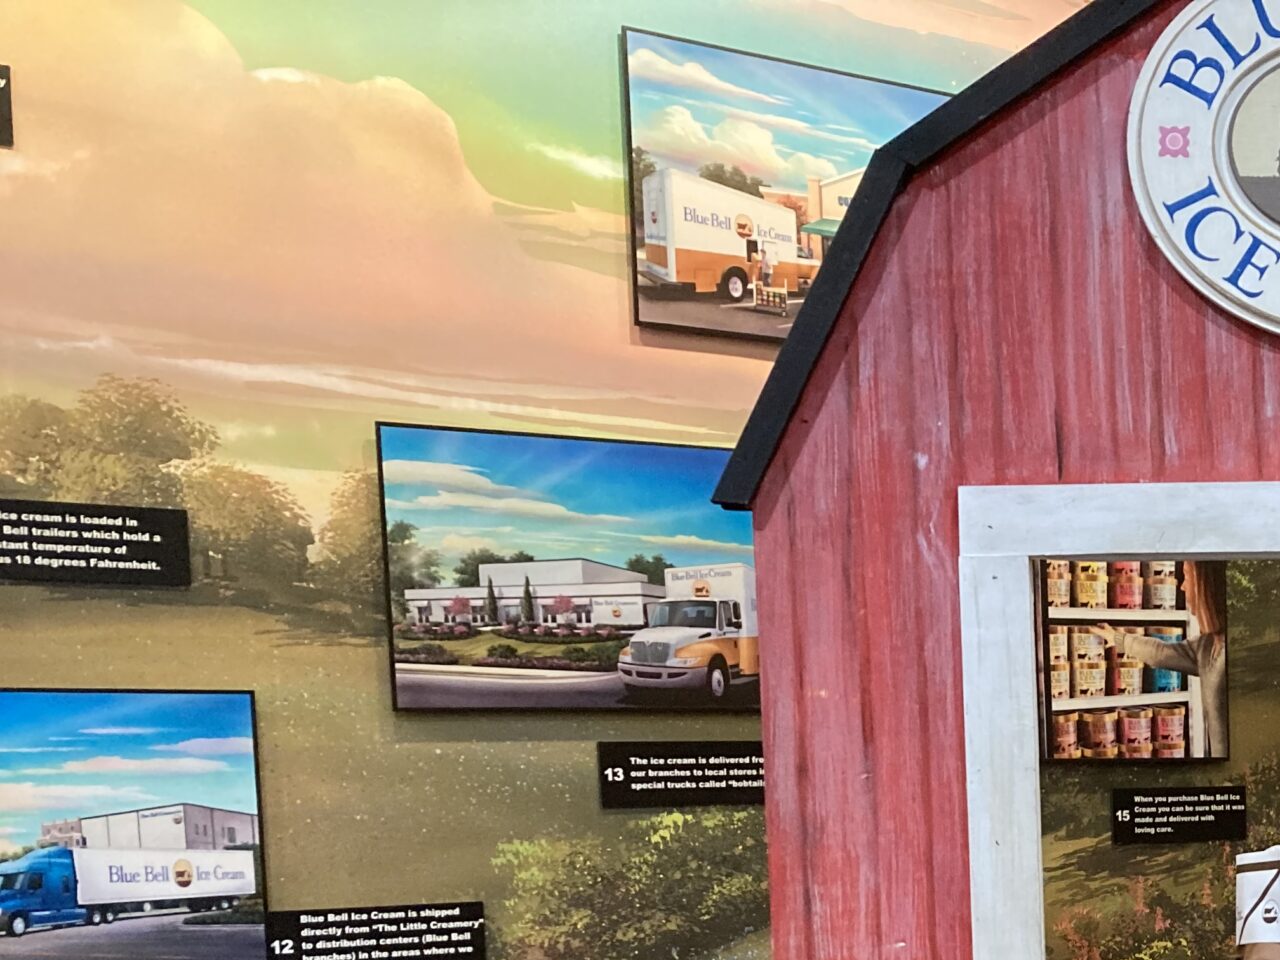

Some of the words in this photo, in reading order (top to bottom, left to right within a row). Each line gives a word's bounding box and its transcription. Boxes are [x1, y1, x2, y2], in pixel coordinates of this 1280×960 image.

[683, 206, 710, 226] Blue
[711, 213, 731, 230] Bell
[757, 223, 768, 239] Ice
[768, 227, 793, 243] Cream
[21, 512, 62, 522] cream
[65, 514, 77, 524] is
[80, 515, 123, 527] loaded
[125, 517, 138, 527] in
[3, 525, 28, 536] Bell
[31, 527, 78, 538] trailers
[82, 530, 120, 540] which
[123, 532, 149, 542] hold
[153, 534, 161, 542] a
[32, 541, 111, 554] temperature
[114, 545, 127, 555] of
[15, 555, 31, 565] 18
[34, 556, 86, 568] degrees
[90, 558, 161, 570] Fahrenheit.
[629, 757, 648, 765] The
[650, 757, 664, 765] ice
[667, 757, 696, 765] cream
[698, 756, 707, 765] is
[709, 755, 750, 764] delivered
[604, 767, 625, 782] 13
[648, 768, 691, 777] branches
[693, 769, 703, 777] to
[705, 768, 727, 776] local
[729, 768, 757, 776] stores
[631, 781, 665, 791] special
[667, 780, 697, 789] trucks
[699, 779, 726, 788] called
[1134, 795, 1153, 803] When
[1155, 796, 1166, 804] you
[1168, 795, 1198, 803] purchase
[1116, 810, 1131, 821] 15
[1185, 804, 1194, 812] be
[1134, 826, 1155, 834] loving
[109, 865, 140, 884] Blue
[144, 865, 169, 882] Bell
[196, 865, 211, 881] Ice
[213, 865, 245, 880] Cream
[300, 914, 325, 924] Blue
[327, 912, 348, 922] Bell
[351, 911, 368, 921] Ice
[371, 910, 406, 920] Cream
[408, 908, 417, 918] is
[419, 907, 460, 919] shipped
[301, 926, 342, 937] directly
[345, 924, 370, 935] from
[400, 921, 427, 931] Little
[270, 939, 294, 955] 12
[302, 940, 313, 950] to
[316, 937, 377, 950] distribution
[379, 935, 420, 946] centers
[422, 933, 449, 944] (Blue
[451, 932, 471, 942] Bell
[358, 951, 369, 960] in
[371, 949, 389, 959] the
[391, 949, 421, 958] areas
[423, 946, 456, 957] where
[457, 945, 474, 953] we
